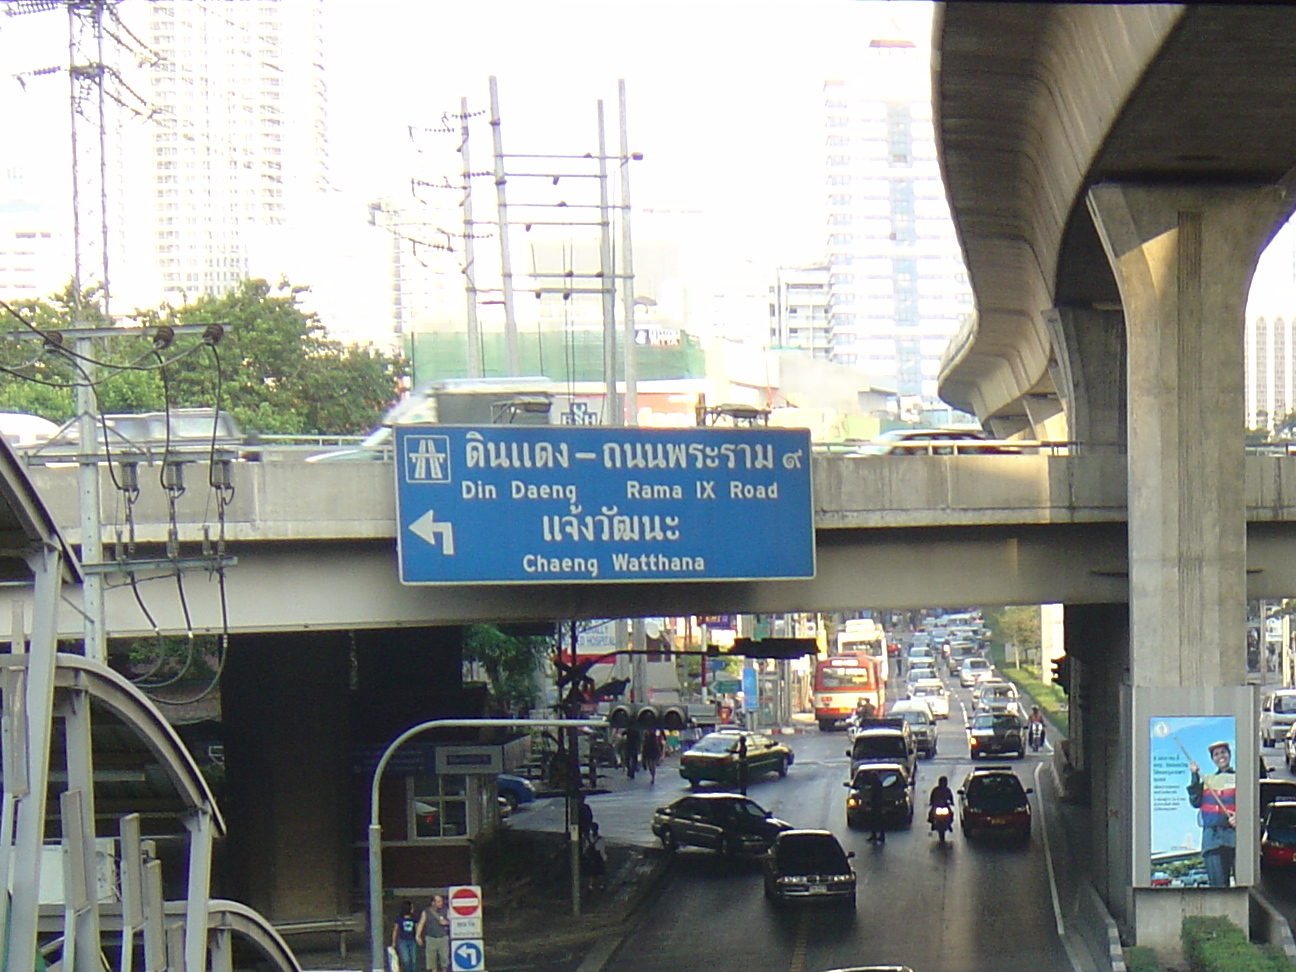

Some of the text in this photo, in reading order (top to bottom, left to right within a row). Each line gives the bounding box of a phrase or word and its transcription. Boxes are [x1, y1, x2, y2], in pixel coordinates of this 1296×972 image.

[465, 431, 569, 469] ดินแดง
[602, 441, 773, 470] ถนนพระราม
[782, 447, 802, 470] ๙
[461, 480, 779, 504] Din Daeng Rama IX Road
[542, 504, 680, 543] แจ้งวัฒนะ
[522, 552, 705, 578] Chaeng Watthana
